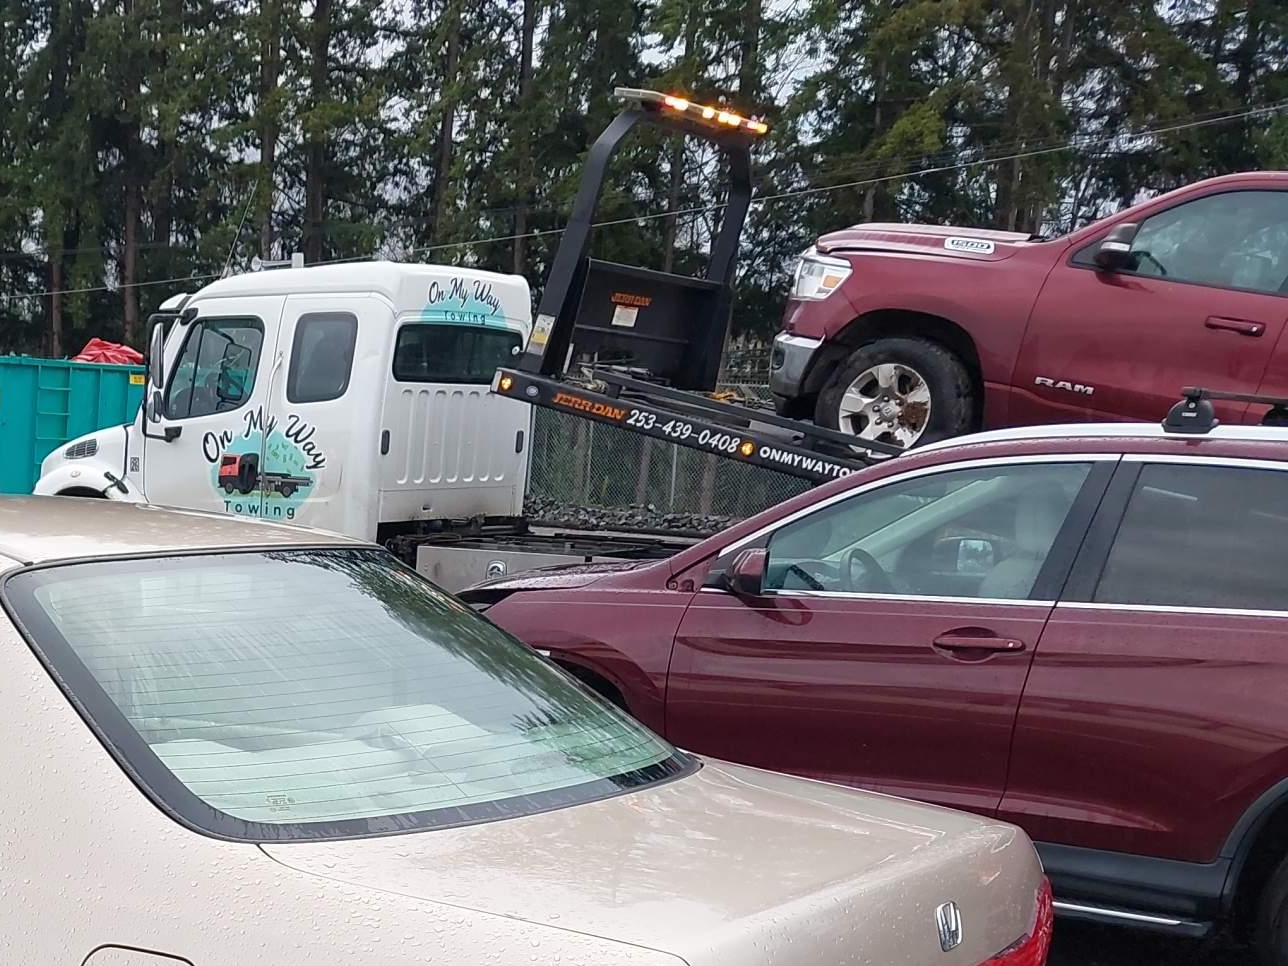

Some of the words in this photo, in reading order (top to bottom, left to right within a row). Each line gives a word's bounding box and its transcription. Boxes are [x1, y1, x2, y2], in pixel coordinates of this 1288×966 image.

[429, 281, 446, 304] On
[449, 277, 469, 308] My
[473, 280, 501, 316] Way
[444, 310, 486, 326] Towing
[1034, 376, 1094, 395] RAM
[202, 430, 233, 464] On
[243, 405, 278, 439] My
[285, 414, 326, 470] Way
[626, 409, 741, 453] 253-439-0408
[223, 500, 296, 519] Towing
